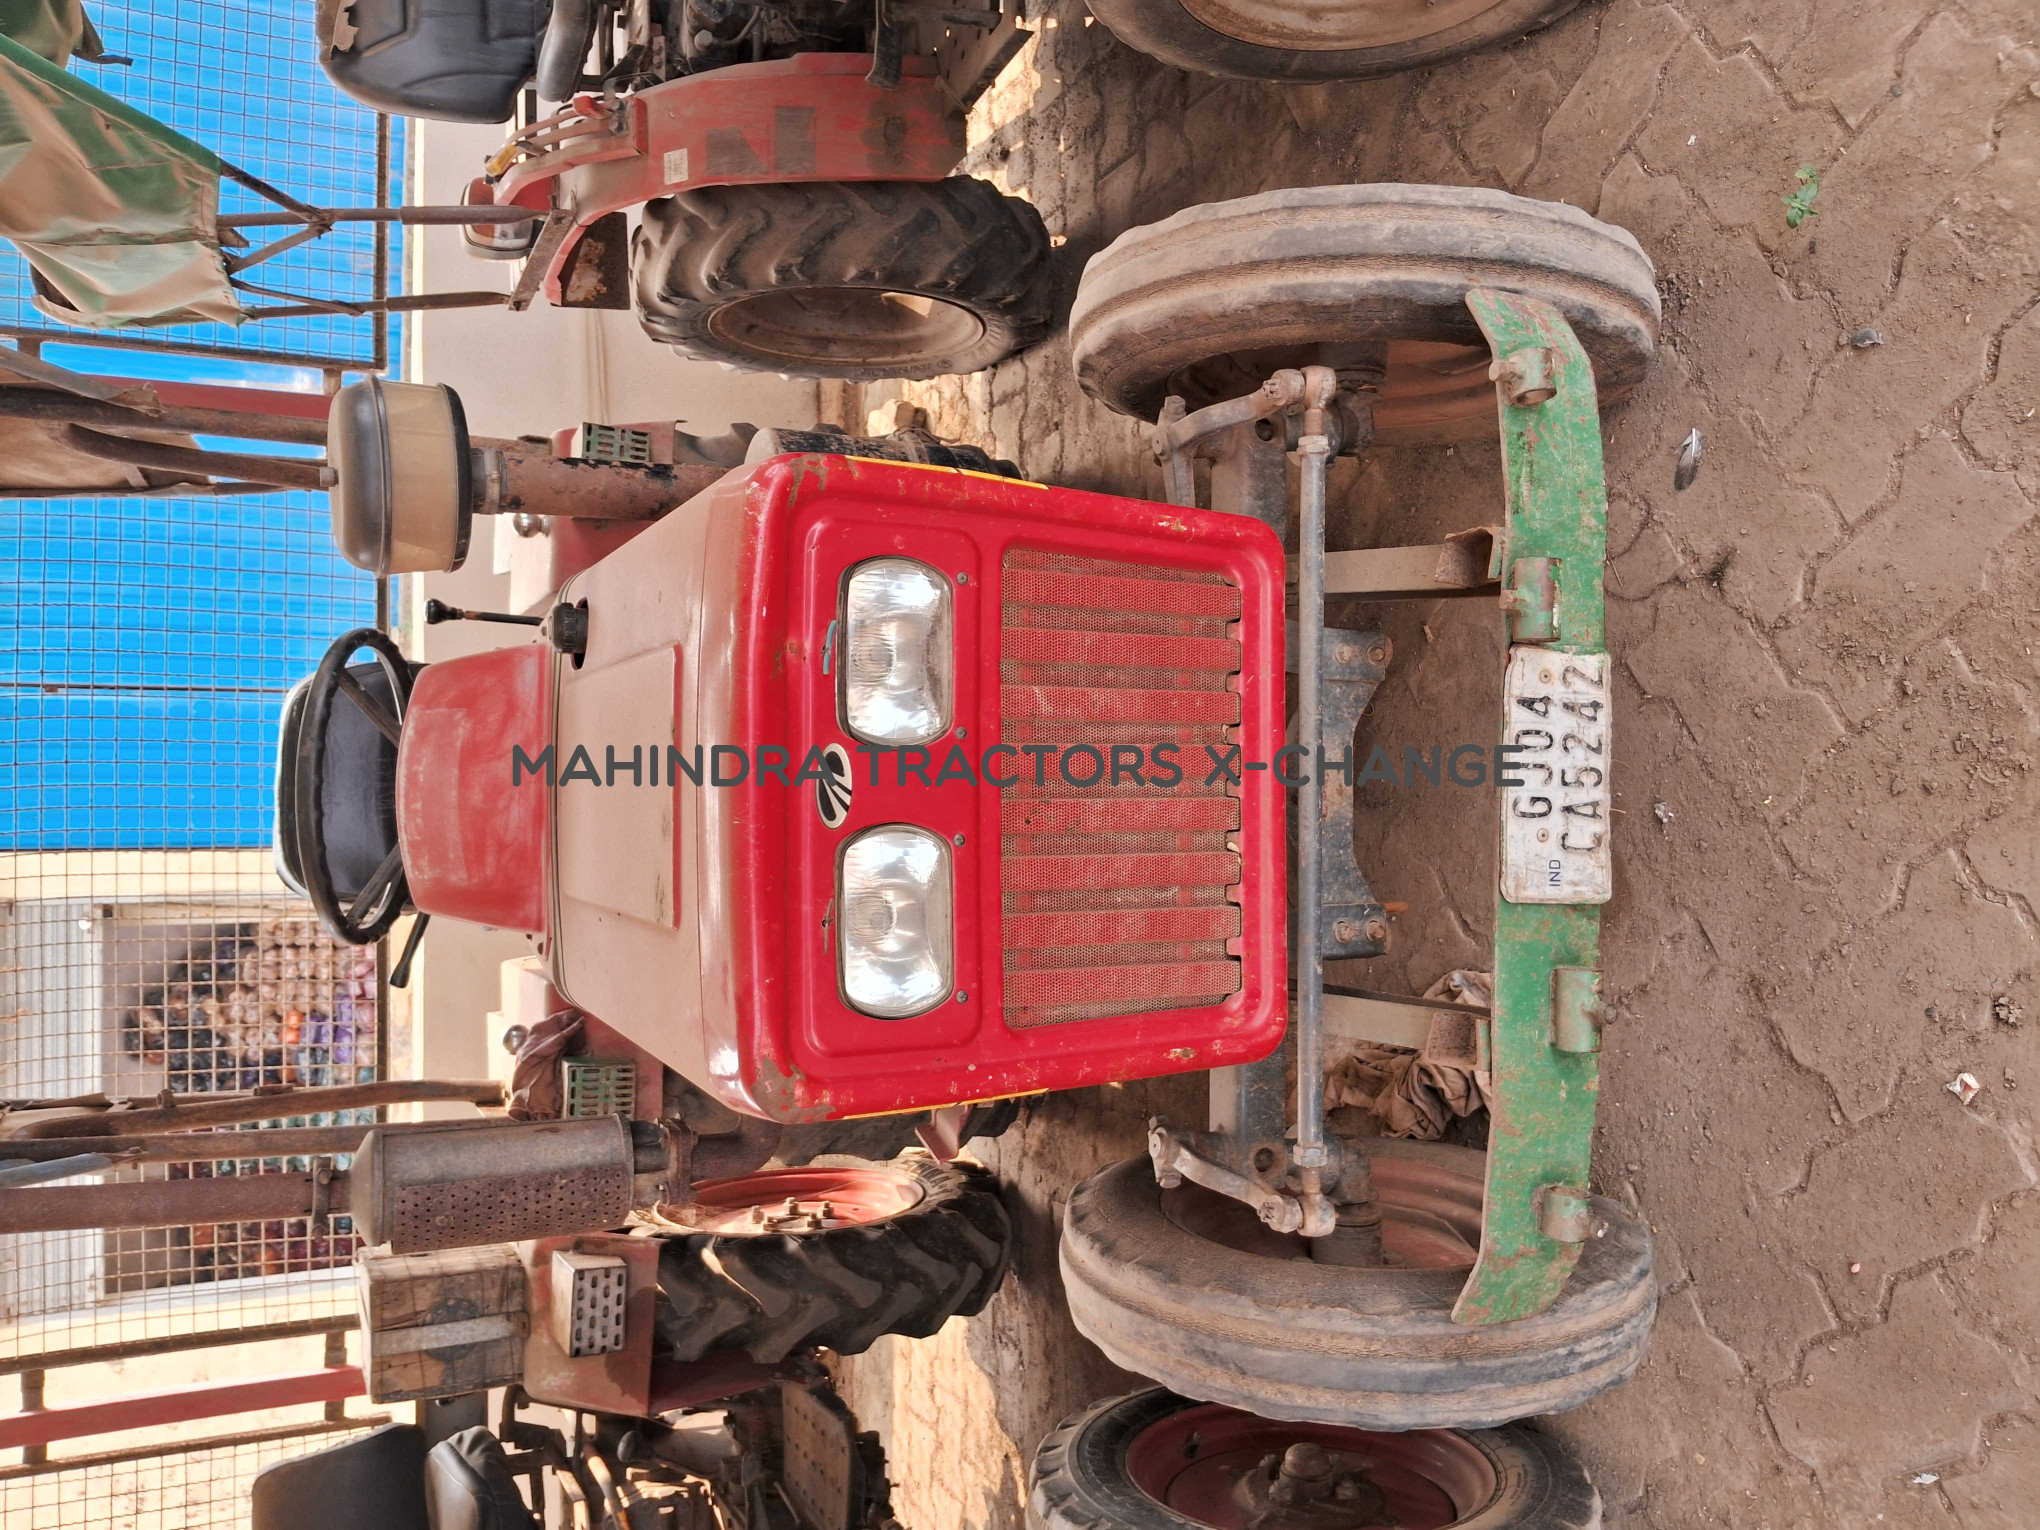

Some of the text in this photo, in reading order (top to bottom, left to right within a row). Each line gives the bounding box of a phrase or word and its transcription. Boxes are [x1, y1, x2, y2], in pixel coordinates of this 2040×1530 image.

[1513, 695, 1554, 819] GJ04
[1560, 665, 1604, 854] CA5242
[1549, 859, 1562, 888] IND
